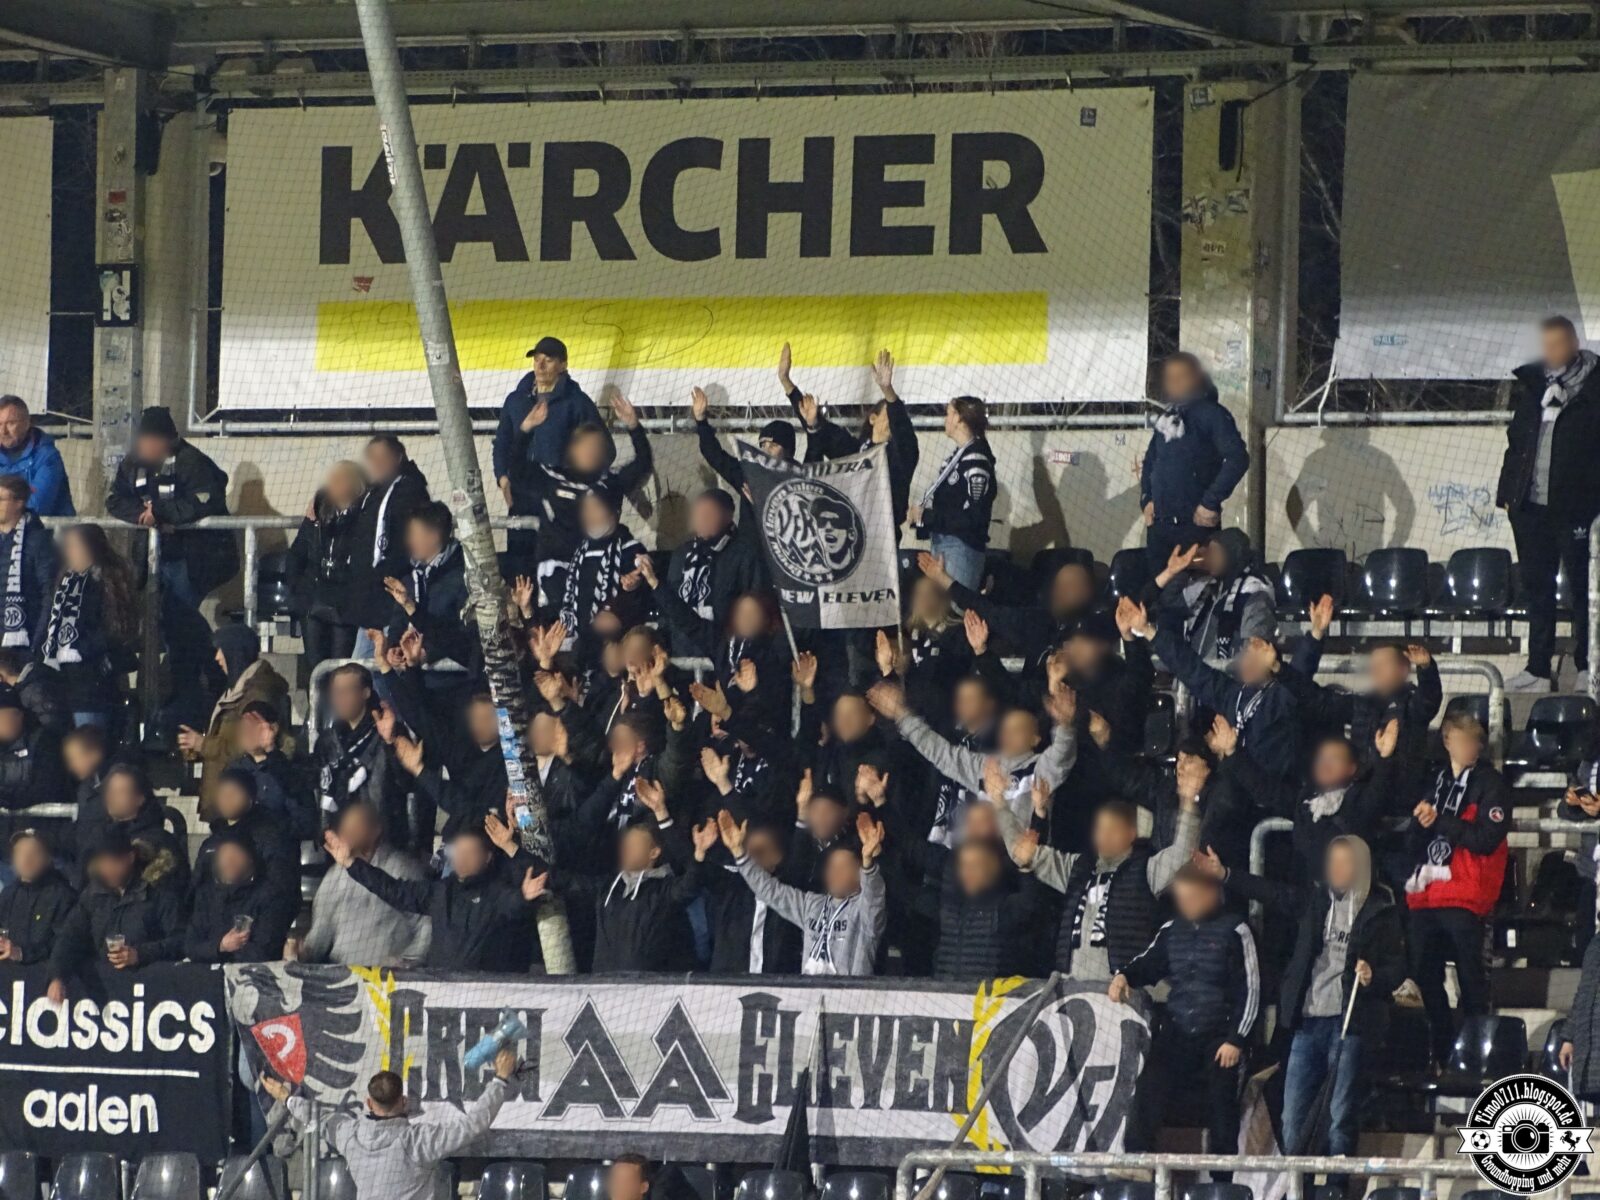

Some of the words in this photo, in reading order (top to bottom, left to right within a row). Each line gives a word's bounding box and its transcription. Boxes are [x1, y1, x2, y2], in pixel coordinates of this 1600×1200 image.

[319, 132, 1048, 265] KÄRCHER
[823, 588, 896, 604] ELEVEN
[0, 981, 215, 1053] lassics
[733, 991, 975, 1125] ELEVEN
[23, 1084, 159, 1135] aalen
